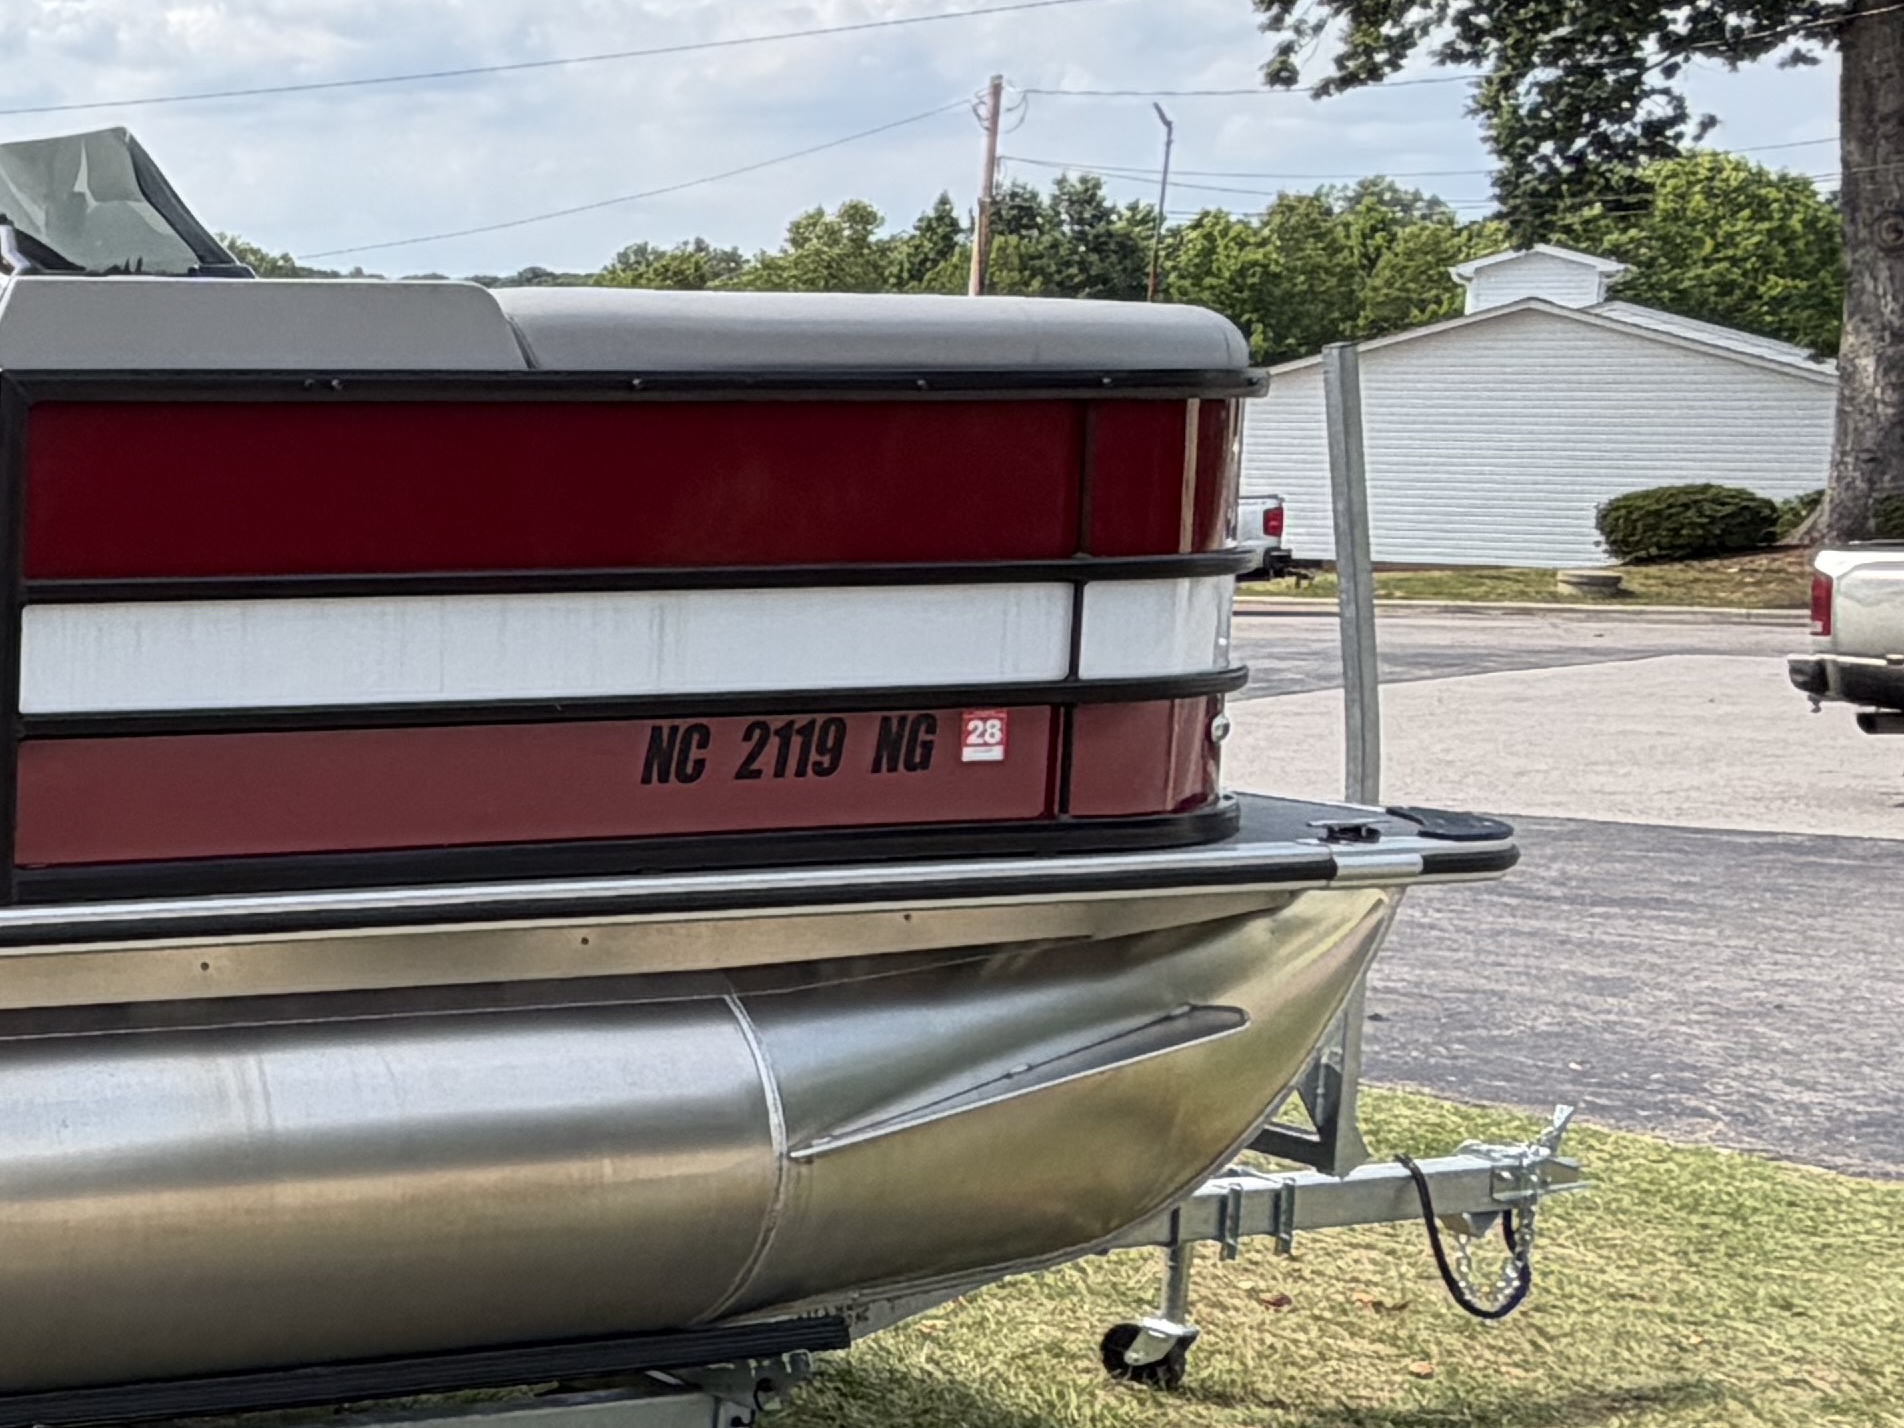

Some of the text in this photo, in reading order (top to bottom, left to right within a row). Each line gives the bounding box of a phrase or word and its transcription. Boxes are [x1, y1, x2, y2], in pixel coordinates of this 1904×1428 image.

[640, 713, 938, 785] NC 2119 NG
[966, 718, 1002, 745] 28
